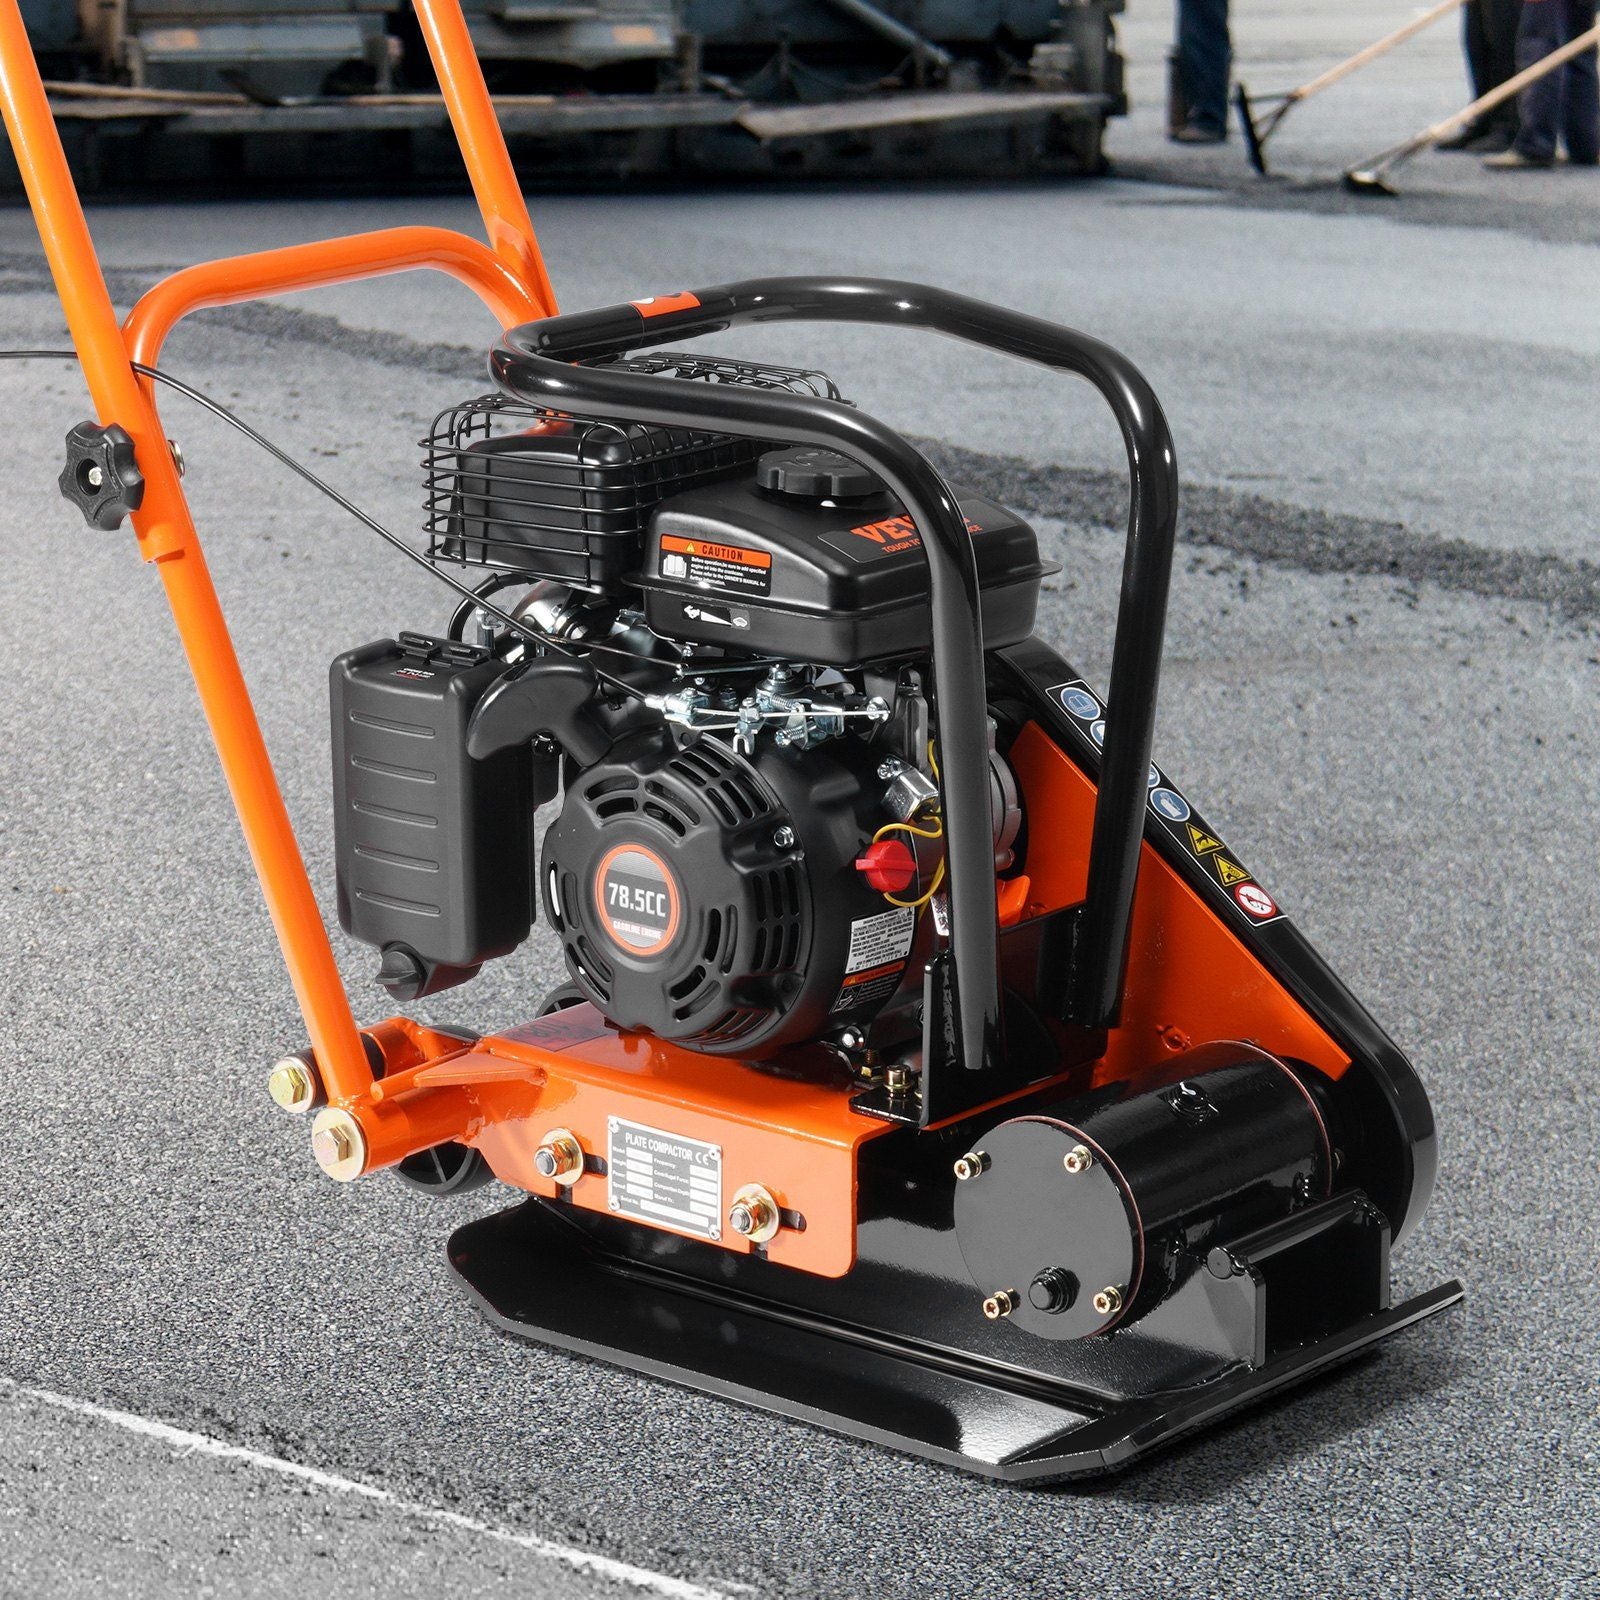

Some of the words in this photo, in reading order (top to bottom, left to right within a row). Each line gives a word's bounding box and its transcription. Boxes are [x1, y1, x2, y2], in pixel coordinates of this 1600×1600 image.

[702, 544, 743, 561] CAUTION
[881, 541, 912, 553] TOUGH
[691, 556, 704, 564] Before
[608, 882, 666, 918] 78.5CC
[625, 1132, 648, 1149] PLATE
[648, 1139, 693, 1161] COMPACTOR
